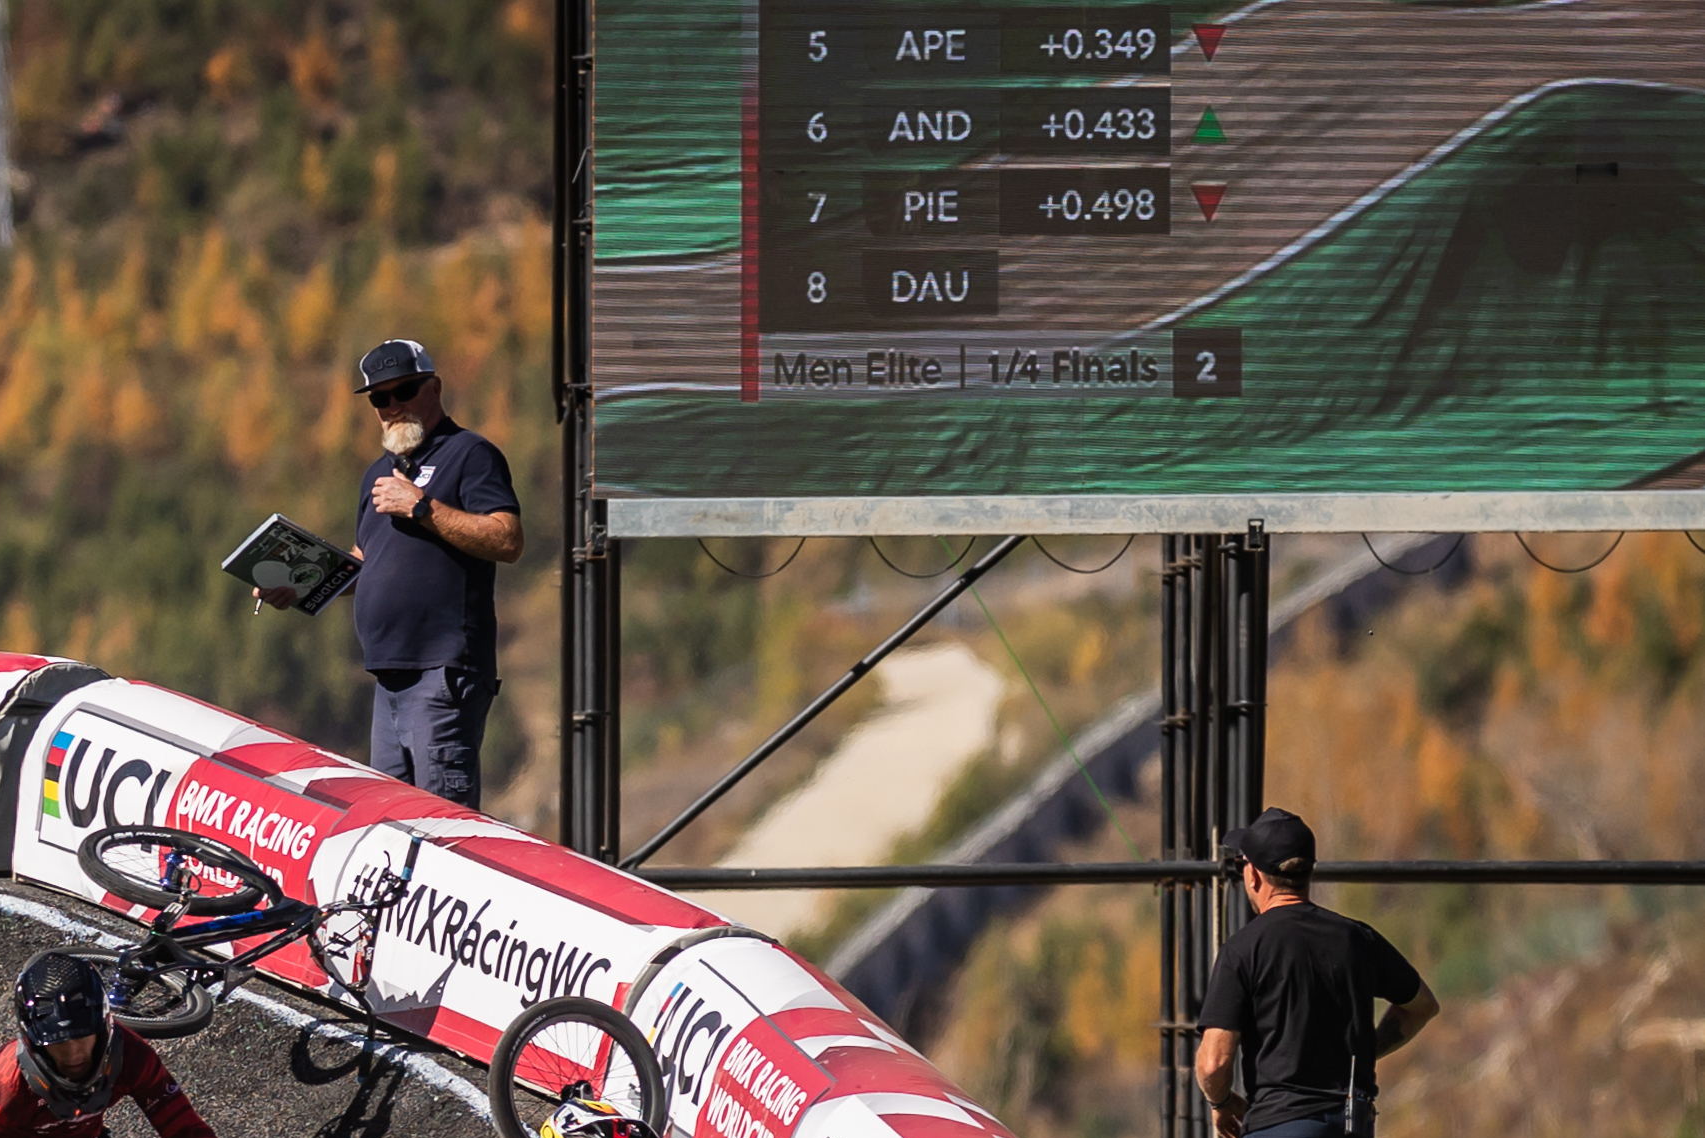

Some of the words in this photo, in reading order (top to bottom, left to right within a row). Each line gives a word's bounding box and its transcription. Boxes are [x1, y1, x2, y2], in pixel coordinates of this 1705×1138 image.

[807, 30, 829, 62] 5
[894, 29, 967, 61] APE
[1039, 28, 1157, 61] +0.349
[806, 111, 828, 143] 6
[887, 110, 972, 142] AND
[1041, 108, 1157, 140] +0.433
[807, 192, 828, 223] 7
[903, 190, 959, 222] PIE
[1038, 190, 1157, 221] +0.498
[806, 271, 828, 304] 8
[890, 270, 970, 303] DAU
[773, 352, 853, 386] Men
[866, 348, 943, 386] Elite
[987, 348, 1041, 388] 1/4
[1052, 347, 1159, 387] Finals
[1196, 350, 1218, 383] 2
[304, 571, 350, 611] swatch
[64, 737, 172, 851] UCI
[176, 779, 235, 833] BMX
[229, 799, 315, 860] RACING
[661, 985, 733, 1106] UCI
[723, 1036, 761, 1091] BMX
[751, 1066, 808, 1127] RACING
